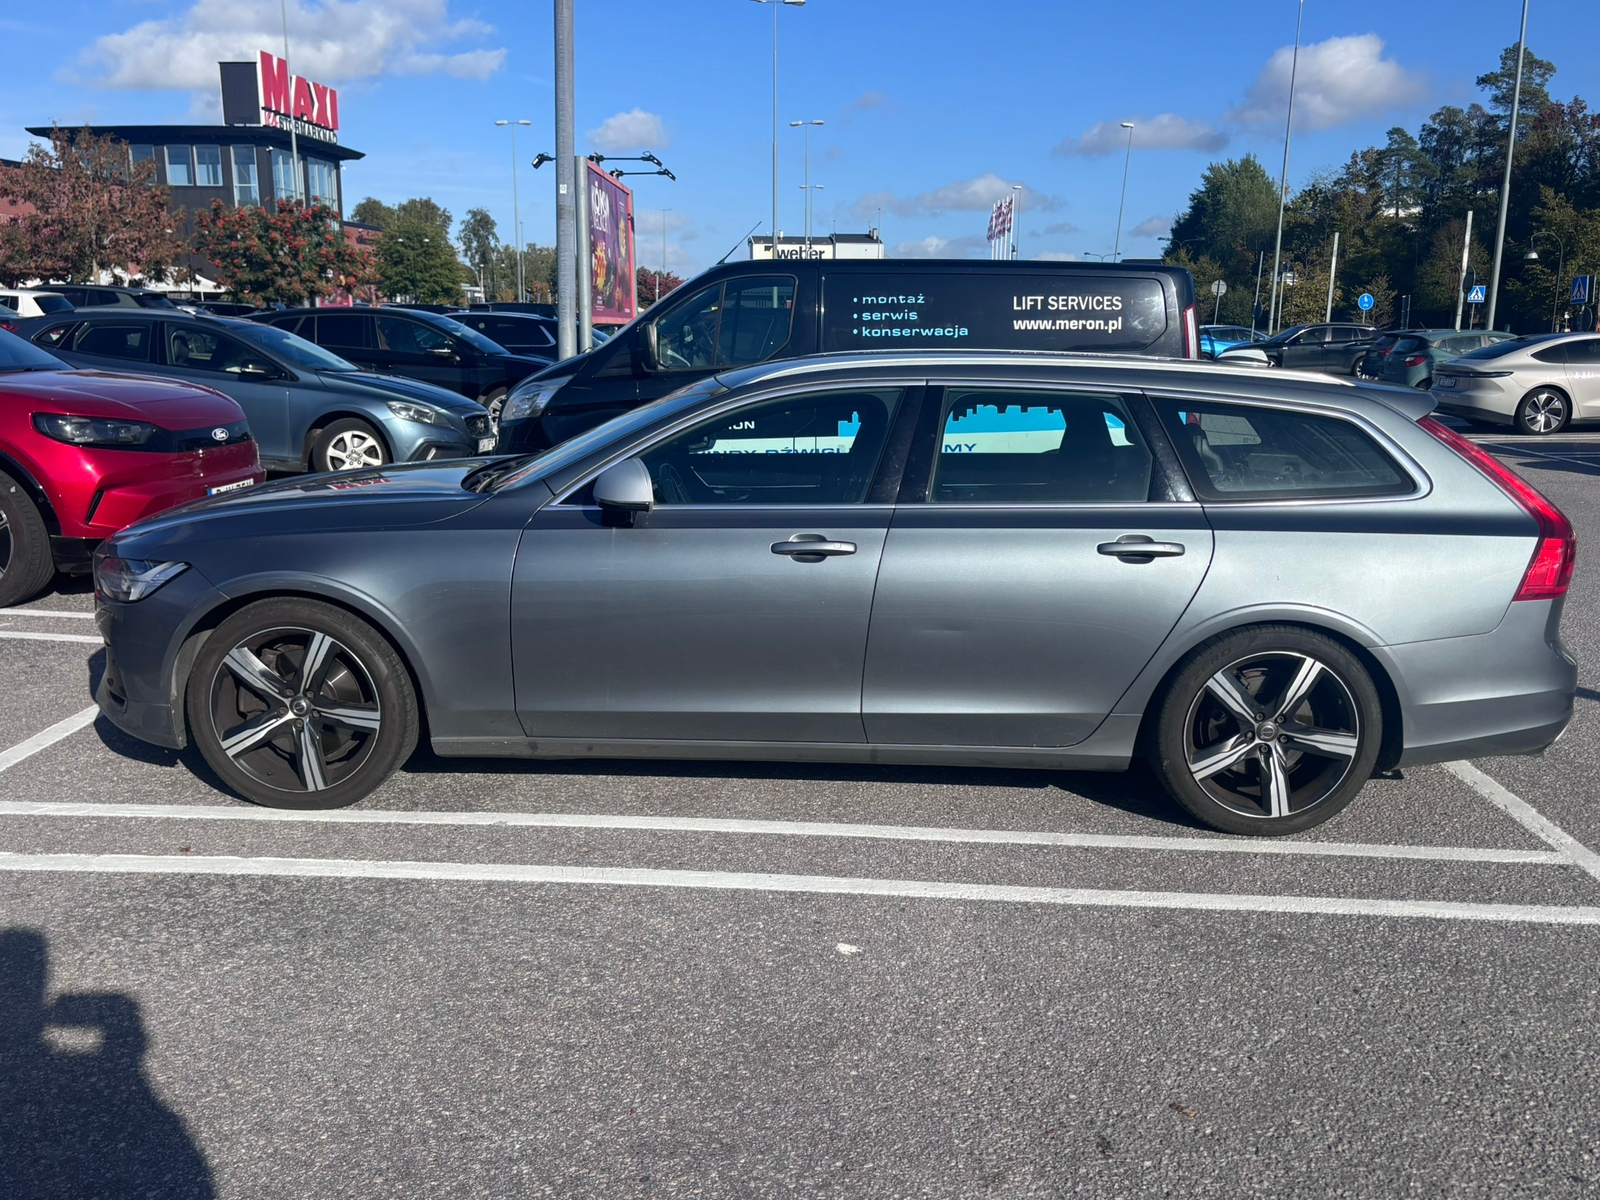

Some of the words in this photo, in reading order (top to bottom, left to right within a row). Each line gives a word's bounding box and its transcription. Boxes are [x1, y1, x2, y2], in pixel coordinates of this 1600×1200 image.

[258, 50, 339, 131] MAXI
[862, 293, 925, 304] montaż
[1013, 296, 1045, 310] LIFT
[1048, 296, 1122, 310] SERVICES
[862, 309, 918, 321] serwis
[862, 325, 969, 339] konserwacja
[1013, 316, 1122, 334] www.meron.pl
